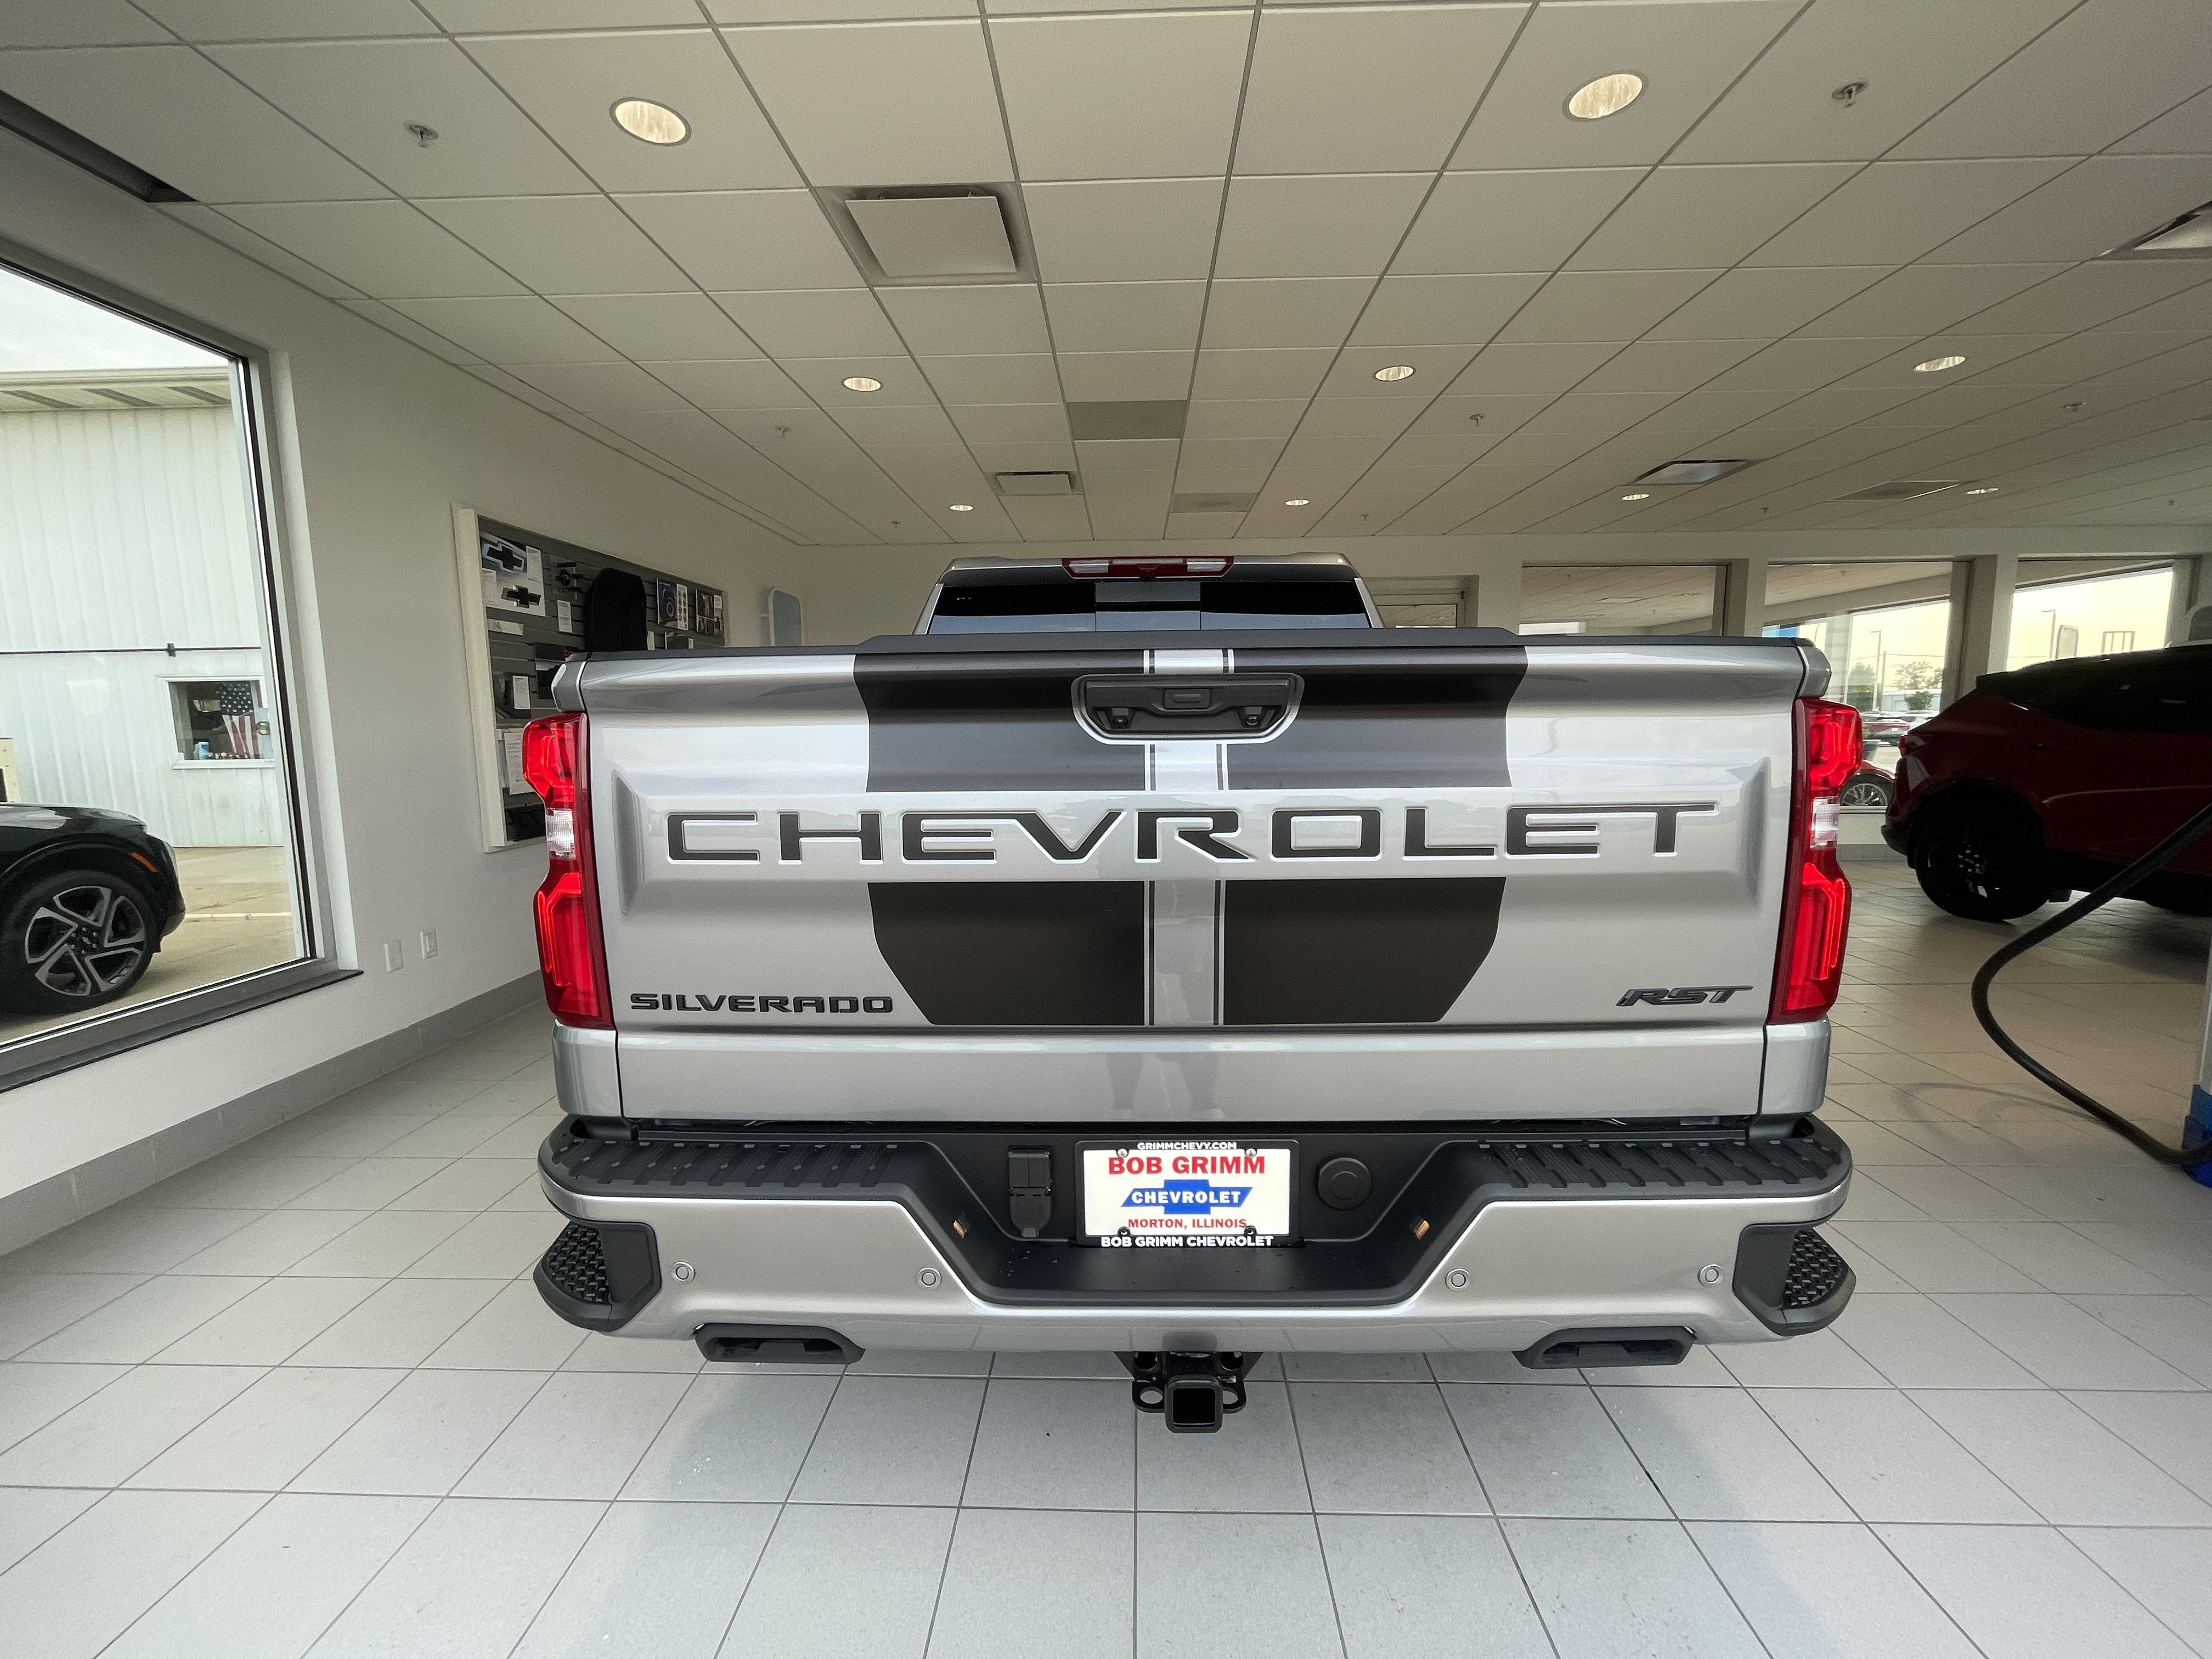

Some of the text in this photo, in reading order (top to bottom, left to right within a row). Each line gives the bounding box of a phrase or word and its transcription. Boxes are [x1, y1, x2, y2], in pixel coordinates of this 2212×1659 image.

[666, 802, 1718, 864] CHEVROLET
[630, 993, 893, 1014] SILVERADO
[1615, 985, 1754, 1007] RST
[1137, 1142, 1237, 1150] GRIMMCHEVY.COM
[1108, 1156, 1266, 1175] BOB GRIMM
[1131, 1191, 1242, 1204] CHEVROLET
[1128, 1218, 1247, 1229] MORTON, ILLINOIS
[1101, 1235, 1274, 1248] BOB GRIMM CHEVROLET
